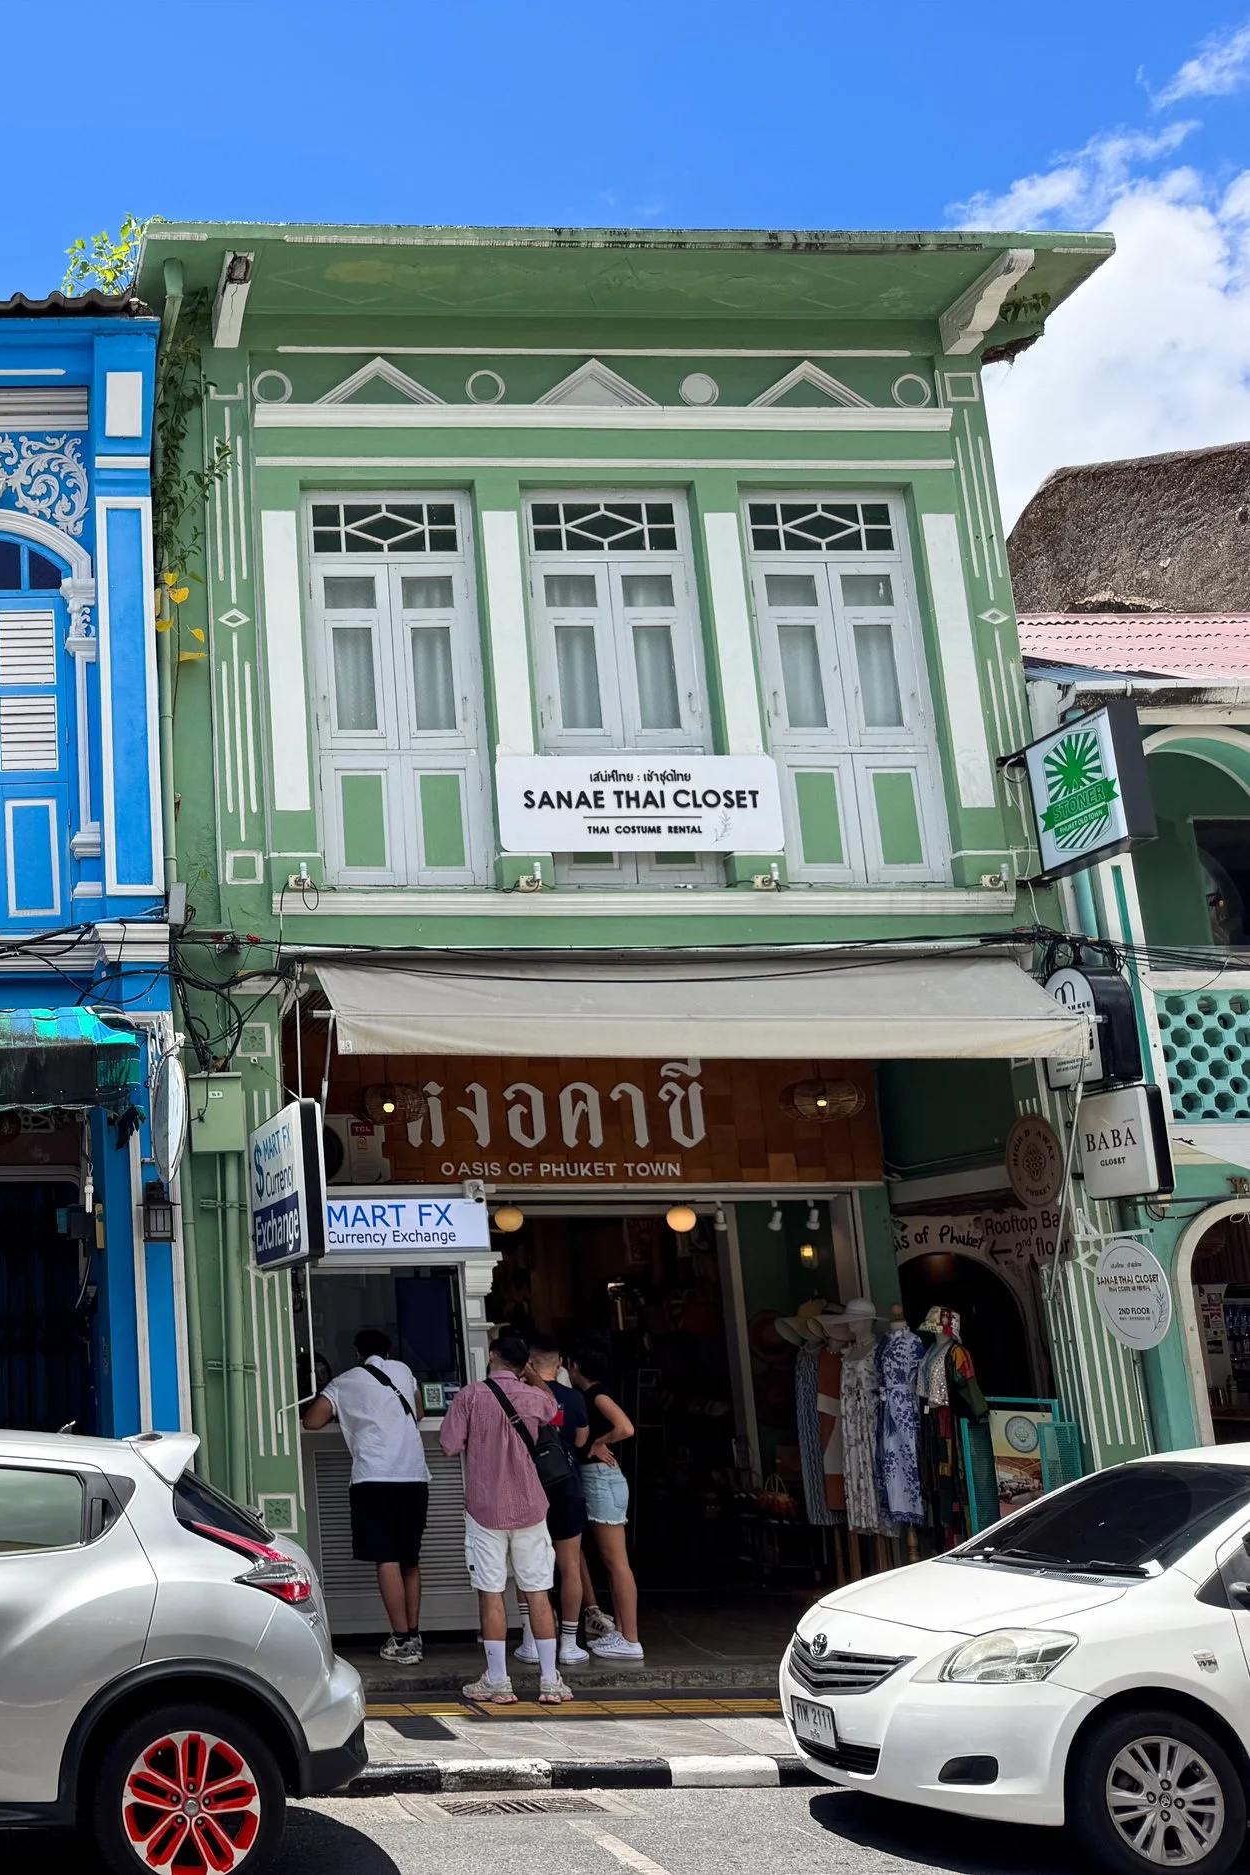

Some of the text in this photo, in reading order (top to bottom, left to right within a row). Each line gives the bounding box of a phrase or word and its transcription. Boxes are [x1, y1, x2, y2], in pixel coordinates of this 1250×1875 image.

[523, 788, 759, 809] SANAE THAI CLOSET
[1053, 783, 1105, 822] STONER
[587, 825, 703, 834] THAI COSTUME RENTAL
[1059, 820, 1078, 834] PHUKET
[1088, 810, 1103, 823] TOWN
[281, 1122, 292, 1150] FX
[353, 1125, 372, 1133] TCL
[1085, 1126, 1137, 1153] BABA
[265, 1163, 294, 1198] Currency
[441, 1161, 681, 1177] OASIS OF PHUKET TOWN
[418, 1203, 454, 1227] FX
[984, 1213, 1038, 1236] Rooftop
[255, 1207, 300, 1252] Exchange
[328, 1229, 457, 1245] Currency Exchange
[914, 1226, 930, 1244] of
[938, 1224, 985, 1250] Phuket
[1118, 1307, 1150, 1315] 2ND FLOOR
